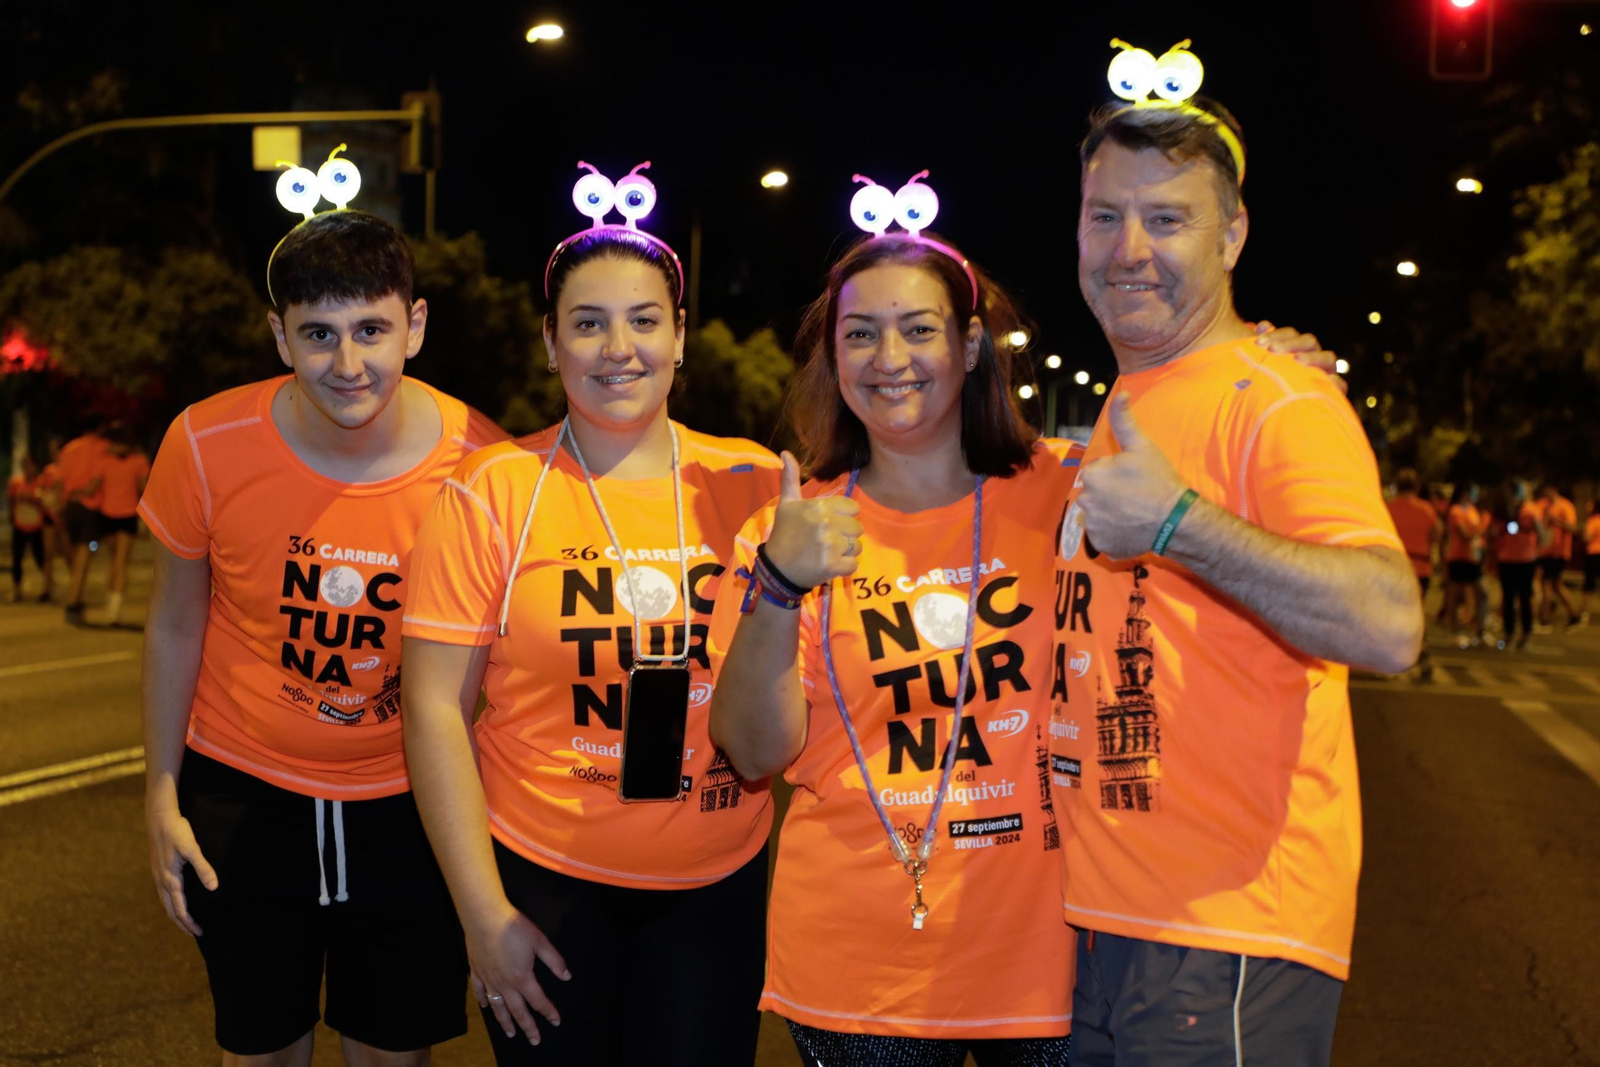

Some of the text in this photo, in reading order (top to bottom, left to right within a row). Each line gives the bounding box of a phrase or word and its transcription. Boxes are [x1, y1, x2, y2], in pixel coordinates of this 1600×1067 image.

[288, 535, 399, 567] 36 CARRERA
[561, 543, 715, 562] 36 CARRERA
[853, 558, 1006, 600] 36 CARRERA
[1055, 570, 1093, 634] UR
[279, 605, 386, 650] TUR
[281, 641, 353, 687] NA
[560, 623, 711, 677] TUR
[326, 685, 340, 693] del
[872, 640, 1032, 715] TUR
[320, 703, 330, 712] 27
[329, 708, 364, 721] septiembre
[572, 683, 623, 731] N
[886, 715, 993, 775] NA
[956, 770, 976, 782] del
[951, 817, 1021, 835] 27 septiembre
[954, 837, 994, 850] SEVILLA
[995, 833, 1021, 846] 2024
